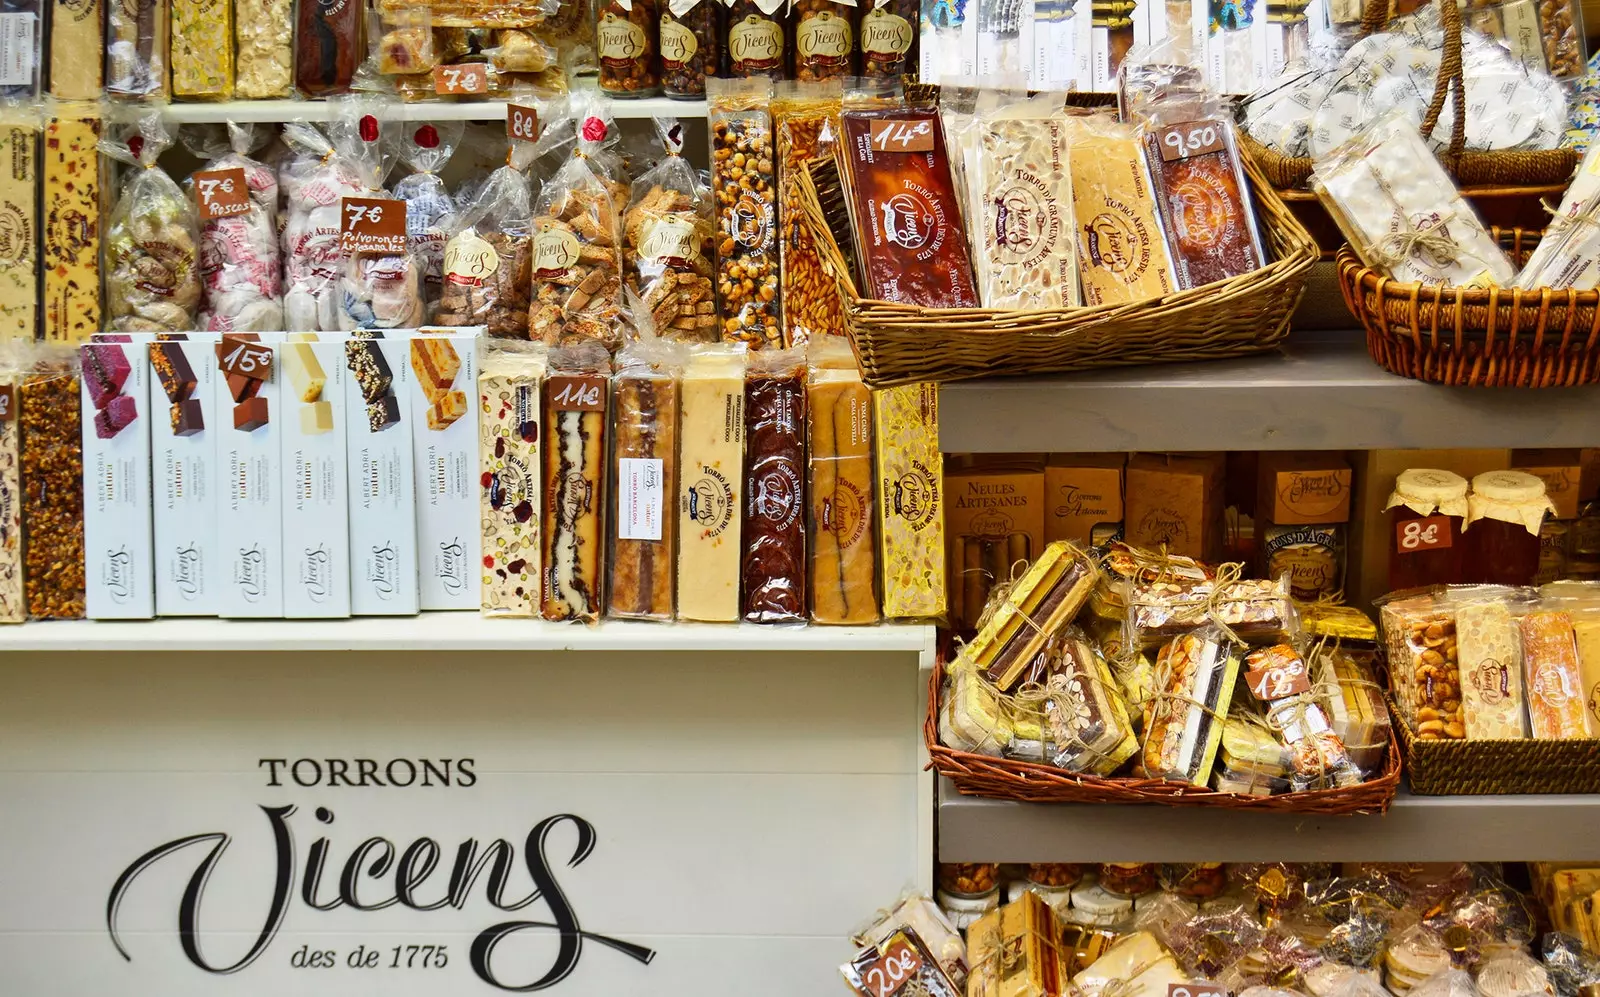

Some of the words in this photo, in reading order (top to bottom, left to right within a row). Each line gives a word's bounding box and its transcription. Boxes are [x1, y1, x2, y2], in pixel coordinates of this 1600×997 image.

[598, 30, 643, 54] Vicens
[660, 34, 694, 55] icens
[731, 32, 783, 57] Vicens
[801, 27, 852, 54] Vicens
[862, 25, 909, 50] Vicens
[443, 69, 478, 92] 7€
[513, 110, 533, 138] 8€
[874, 121, 930, 150] 14€
[198, 178, 235, 205] 7€
[903, 179, 932, 199] TORRÓ
[1015, 168, 1047, 192] TORRÓ
[345, 203, 383, 231] 7€
[930, 199, 948, 227] ARTESÀ
[1103, 196, 1134, 217] TORRÓ
[315, 227, 340, 236] ARTES
[894, 196, 923, 248] Vicens
[1008, 197, 1033, 248] Vicens
[341, 241, 404, 252] Artesanales
[342, 232, 405, 244] Polvorones
[1097, 223, 1127, 266] Vicens
[446, 247, 492, 275] Vicens
[533, 240, 577, 267] Vicens
[916, 246, 935, 261] 1775
[223, 343, 272, 372] 15€
[553, 383, 599, 406] 11€
[645, 462, 656, 491] Vicens
[703, 466, 726, 482] TORRÓ
[776, 460, 795, 479] TORRÓ
[912, 459, 931, 479] TORRÓ
[500, 470, 514, 513] Vicens
[566, 477, 584, 518] Vicens
[838, 477, 860, 494] TORRÓ
[903, 478, 920, 520] Vicens
[968, 481, 1015, 495] NEULES
[698, 480, 715, 525] Vicens
[955, 495, 1028, 508] ARTESANES
[1402, 522, 1438, 549] 8€
[107, 543, 130, 604] Vicens
[176, 540, 198, 601] Vicens
[239, 542, 262, 603] Vicens
[304, 542, 327, 603] Vicens
[371, 540, 394, 601] Vicens
[440, 536, 463, 597] Vicens
[1254, 660, 1303, 699] 12€
[1479, 664, 1500, 704] Vicens
[259, 758, 478, 787] TORRONS
[106, 802, 656, 992] Vicens
[290, 944, 336, 969] des
[347, 944, 378, 969] de
[388, 945, 449, 969] 1775
